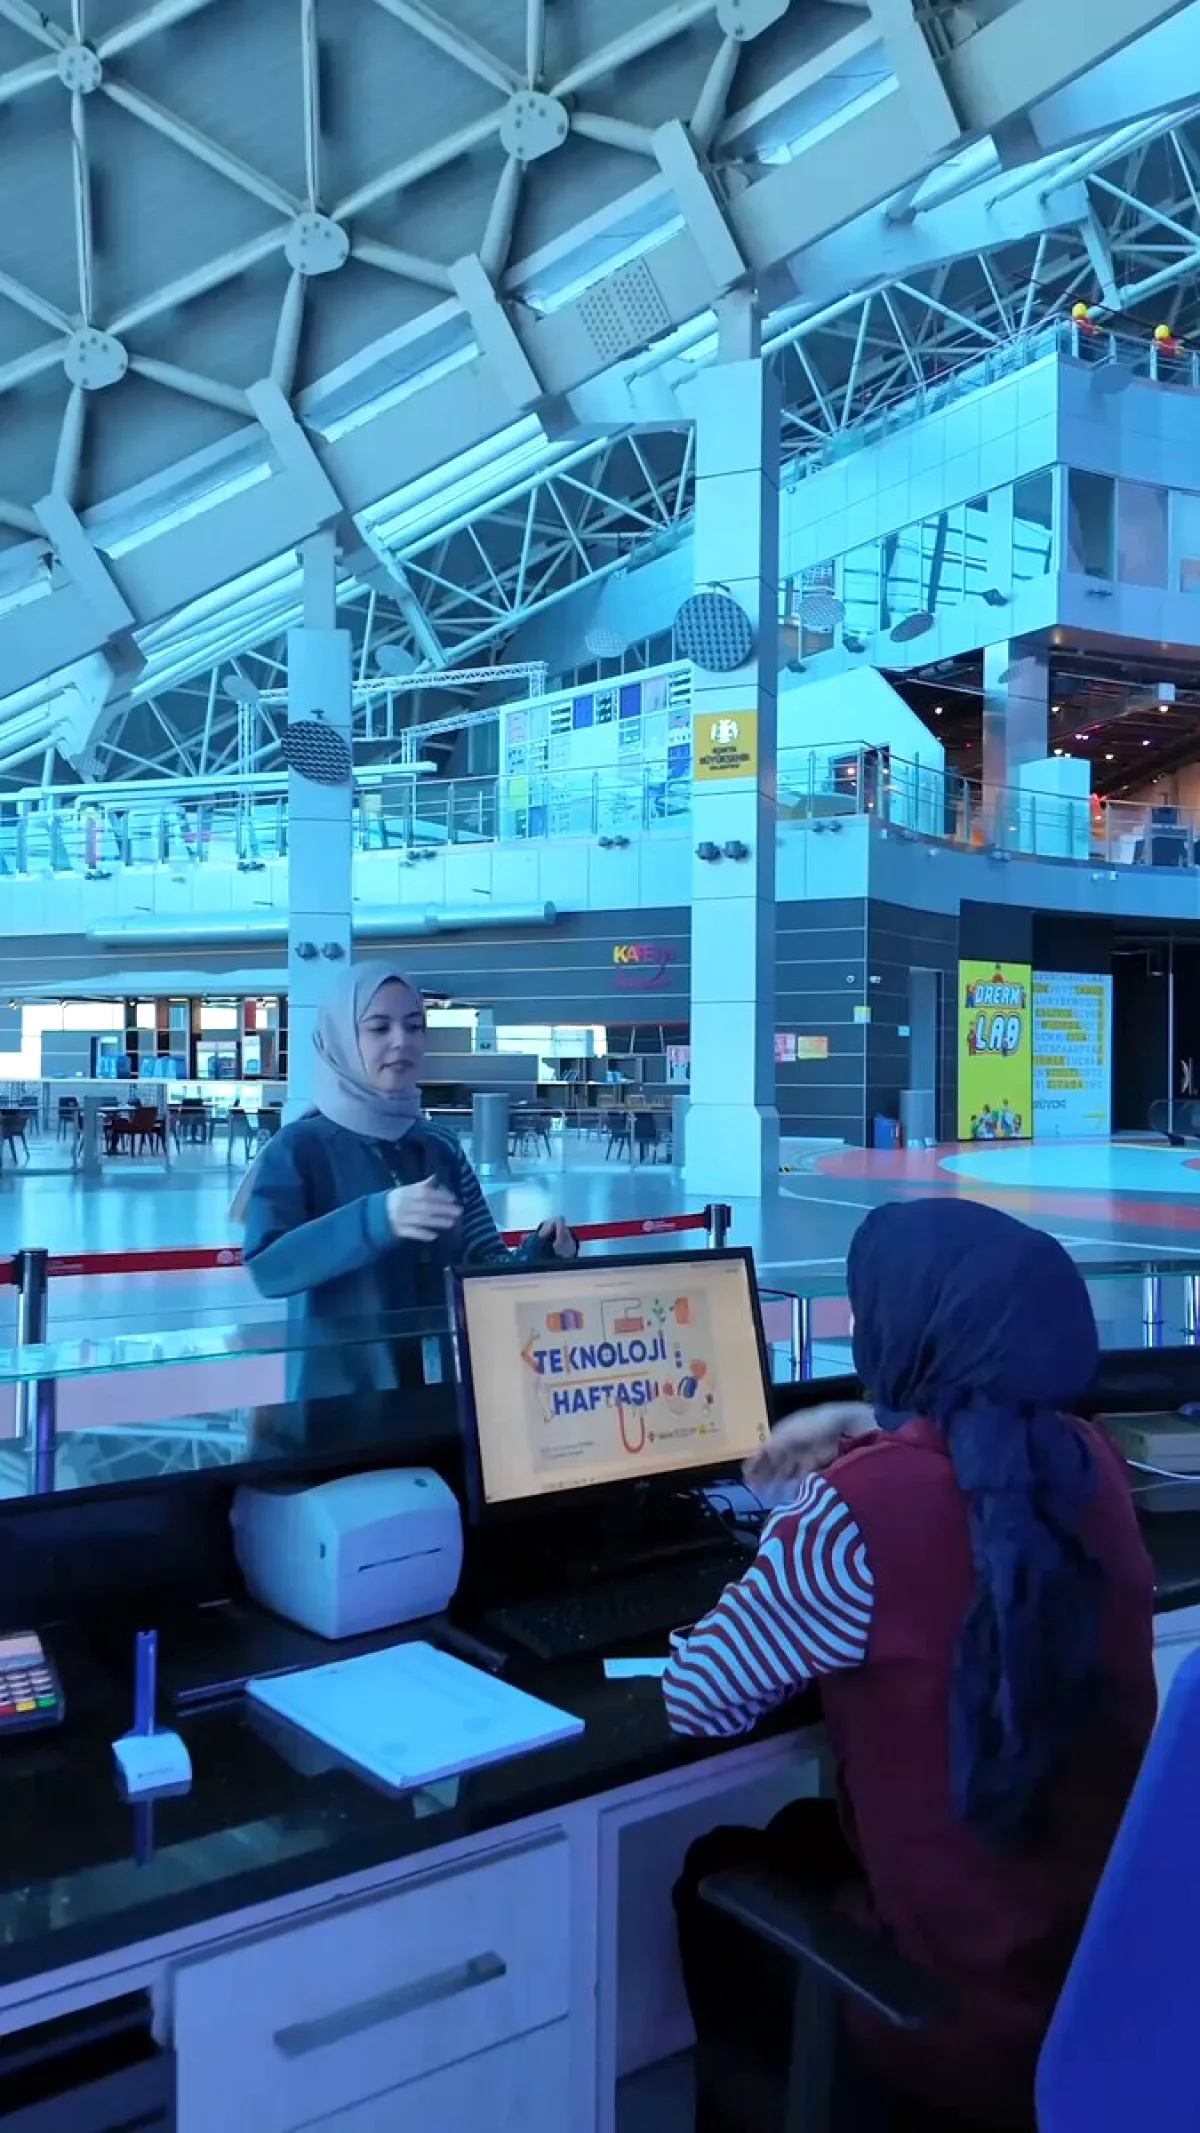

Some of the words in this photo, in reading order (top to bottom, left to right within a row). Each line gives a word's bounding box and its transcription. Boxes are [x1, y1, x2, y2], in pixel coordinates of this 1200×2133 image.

[975, 984, 1021, 1005] DREAM
[976, 1014, 1021, 1051] LAB
[533, 1335, 667, 1375] TEKNOLOJİ
[552, 1379, 652, 1416] HAFTASI
